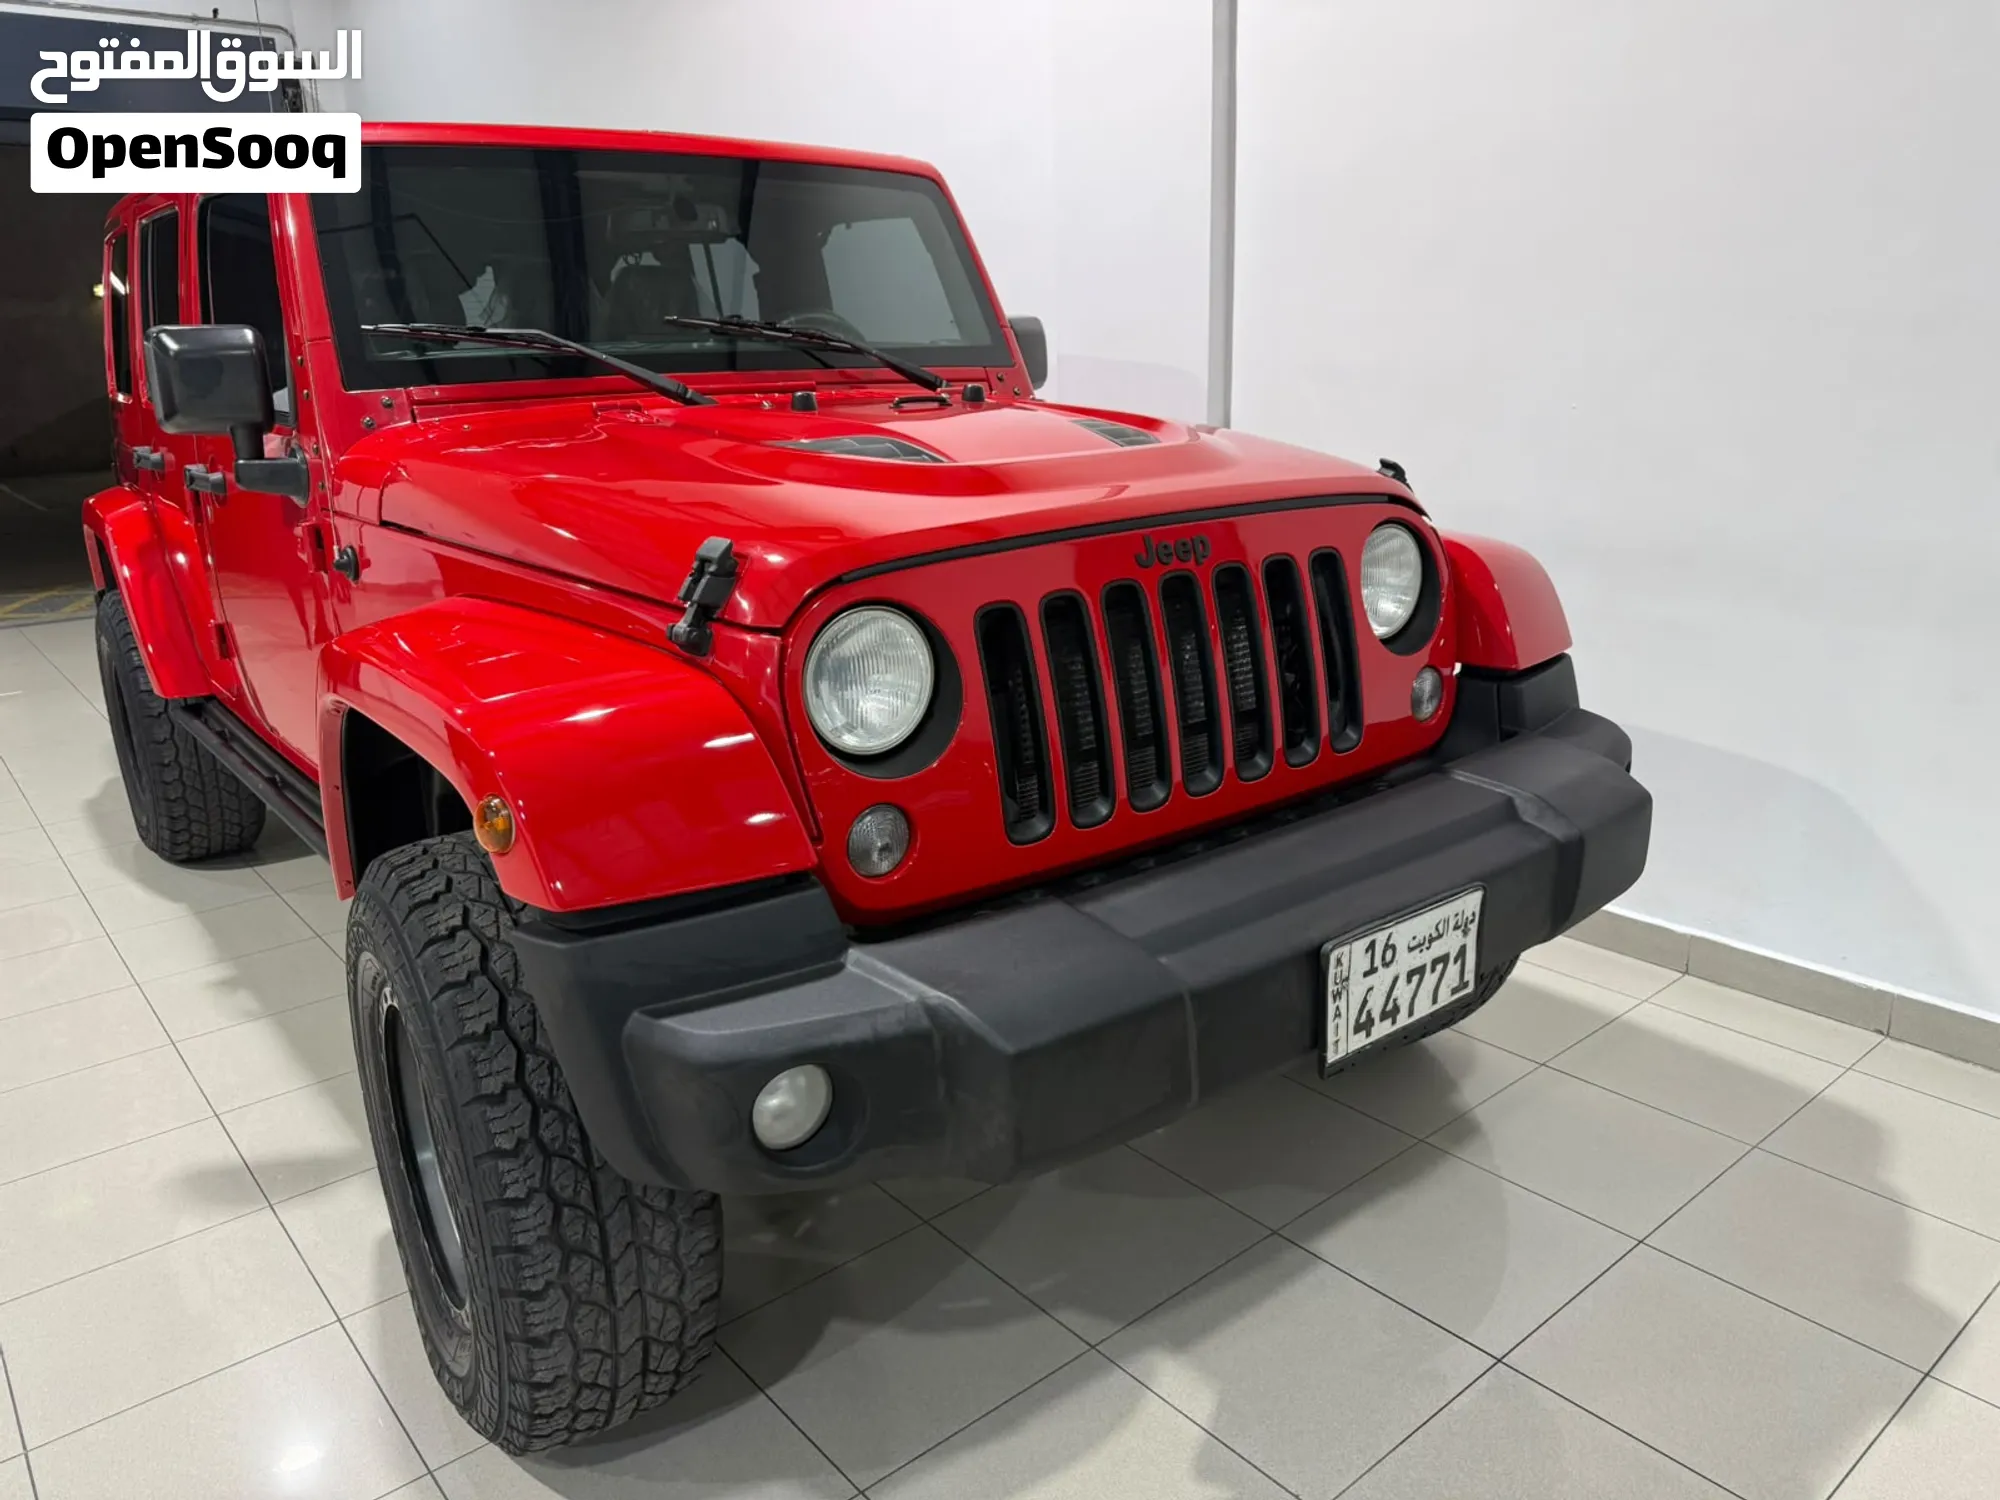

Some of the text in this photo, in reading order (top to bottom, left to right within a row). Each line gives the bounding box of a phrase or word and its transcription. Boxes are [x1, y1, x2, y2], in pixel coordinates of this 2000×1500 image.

[1135, 535, 1210, 568] Jeep
[1362, 930, 1397, 978] 16
[1407, 910, 1476, 954] دولة الكويت
[1331, 952, 1344, 1055] KUWAIT
[1352, 943, 1470, 1039] 44771
